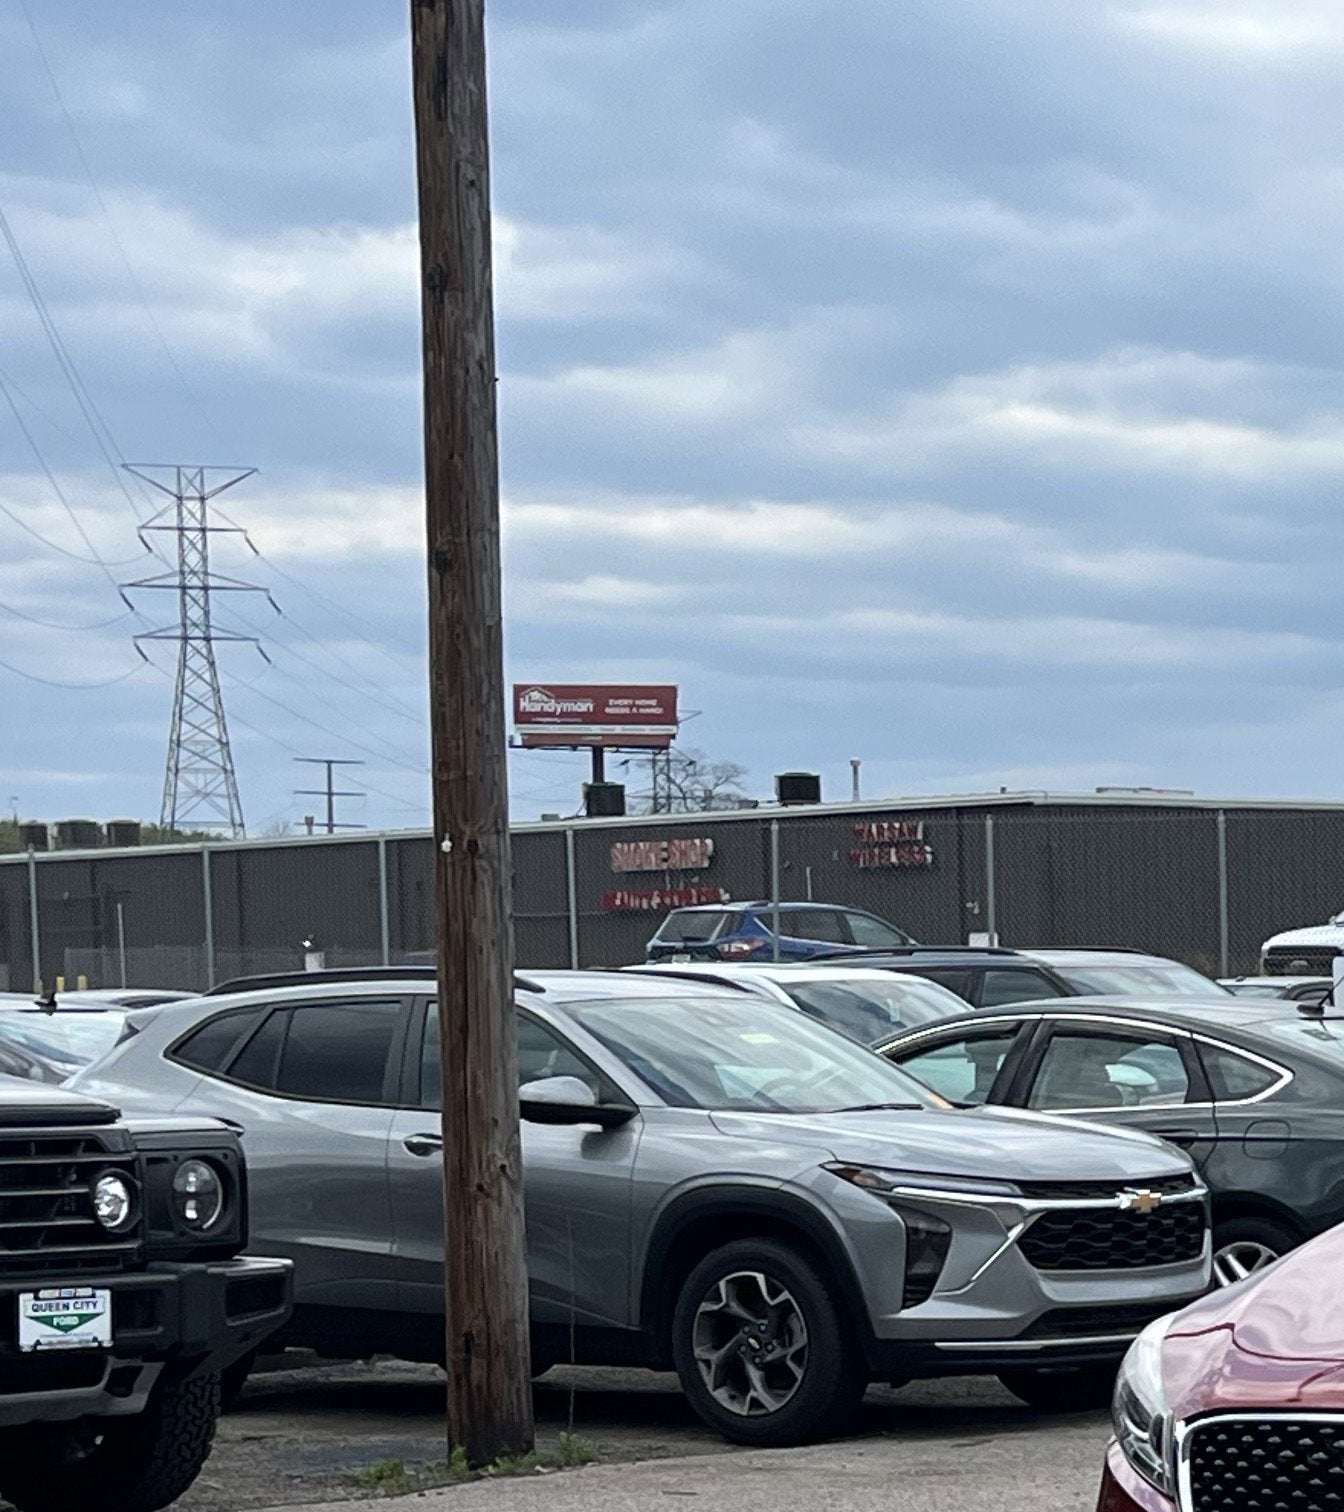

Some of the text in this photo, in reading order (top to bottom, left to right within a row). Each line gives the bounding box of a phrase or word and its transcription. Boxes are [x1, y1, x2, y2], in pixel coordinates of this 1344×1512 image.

[520, 695, 594, 716] Handyman
[32, 1301, 98, 1312] QUEEN CITY
